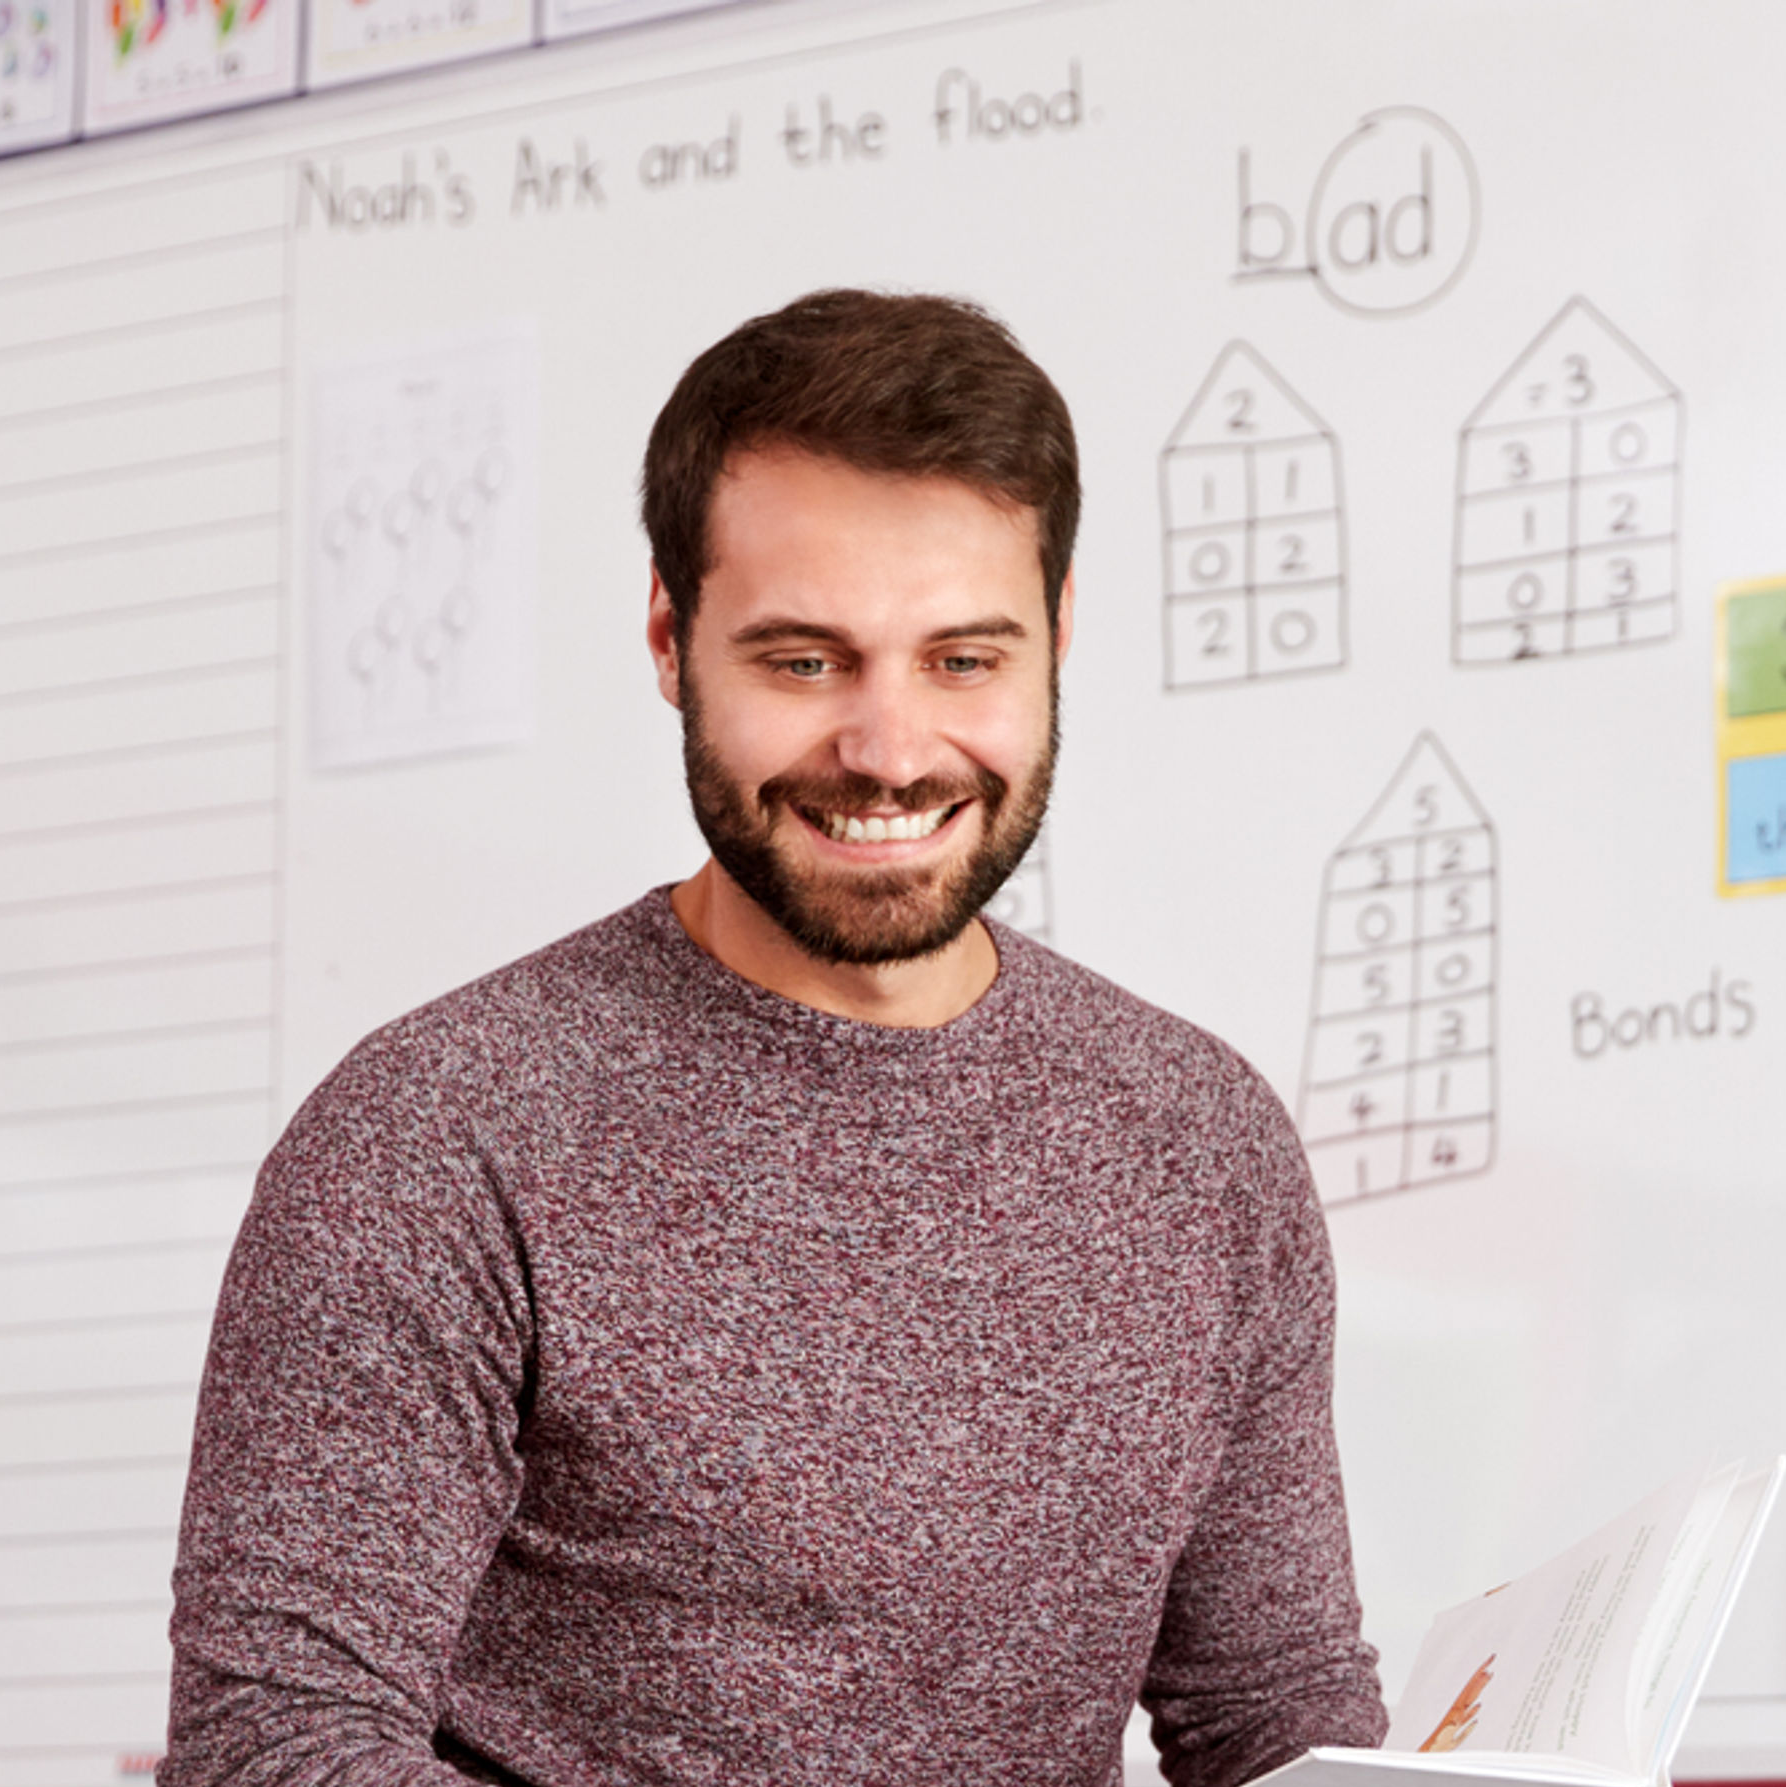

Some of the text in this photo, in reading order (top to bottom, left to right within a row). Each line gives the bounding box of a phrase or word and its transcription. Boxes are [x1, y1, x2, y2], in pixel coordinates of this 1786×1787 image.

[296, 148, 475, 233] Noah's
[509, 134, 610, 217] Ark
[638, 110, 742, 191] and
[781, 92, 890, 171] the
[1236, 142, 1433, 273] bad
[1562, 352, 1595, 406] 3
[1225, 387, 1259, 433] 2
[1501, 420, 1648, 481] 3 0
[1609, 491, 1640, 534] 2
[1188, 533, 1309, 587] 0 2
[1507, 556, 1639, 614] 0 3
[1196, 607, 1319, 659] 2 0
[1356, 901, 1395, 948] 0
[1435, 952, 1471, 988] 0
[1568, 966, 1760, 1063] Bonds
